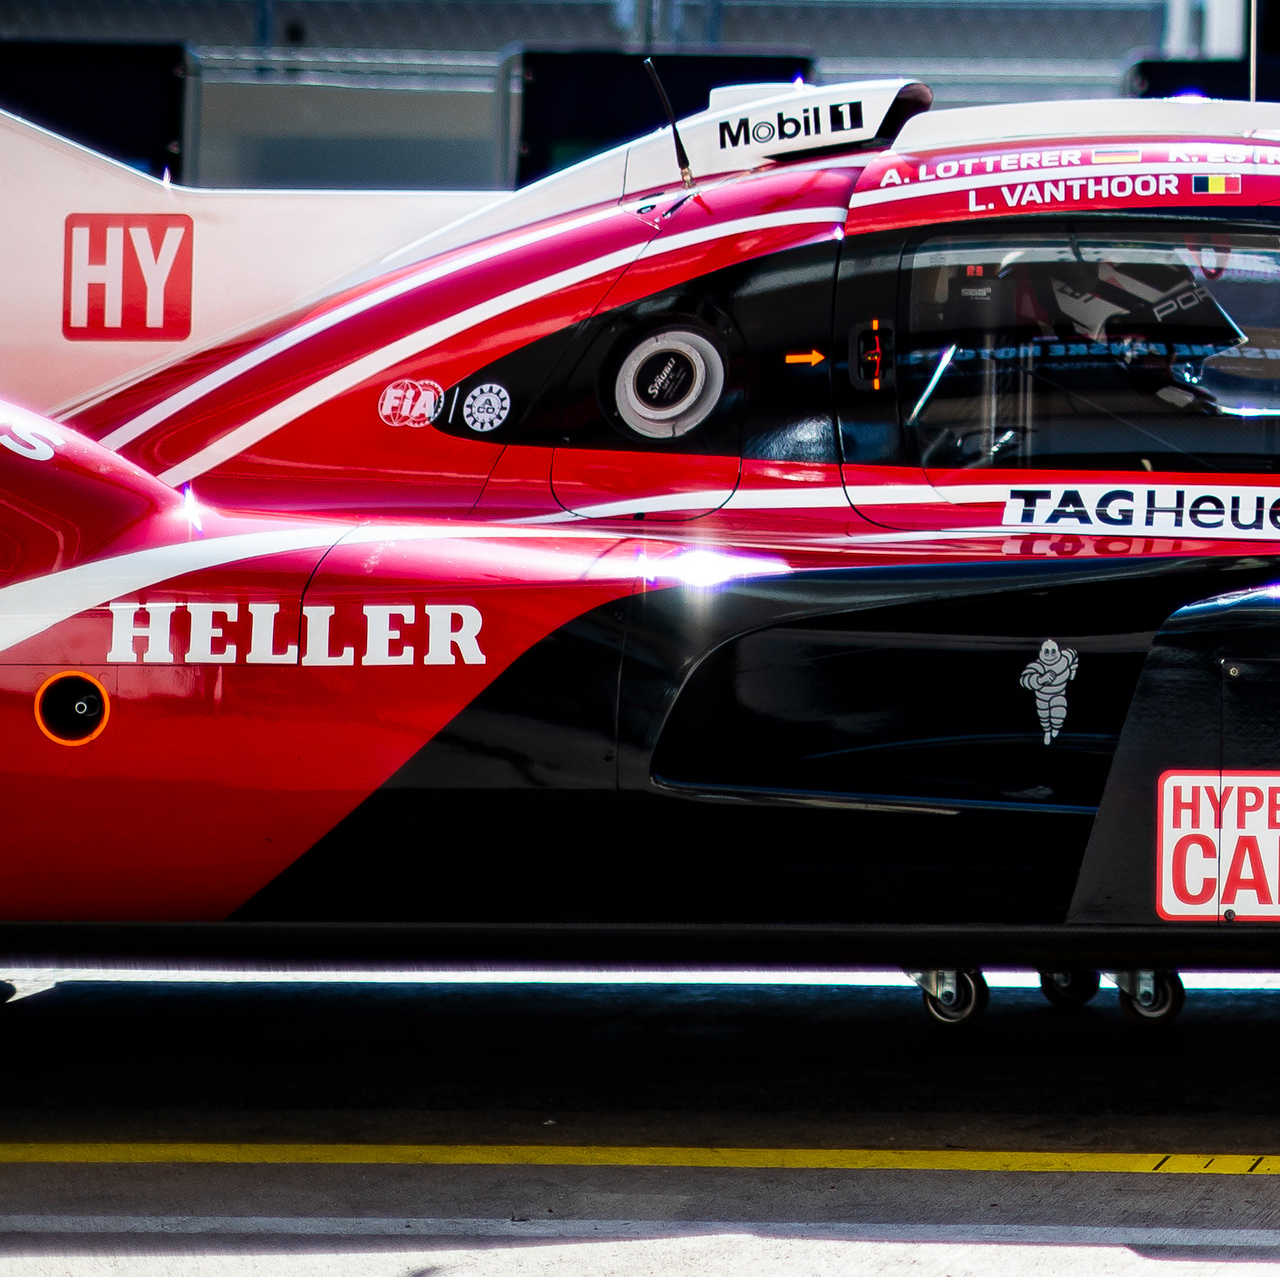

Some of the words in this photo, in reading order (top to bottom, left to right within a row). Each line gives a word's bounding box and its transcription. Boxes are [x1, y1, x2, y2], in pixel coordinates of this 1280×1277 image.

[719, 106, 822, 150] Mobil
[880, 167, 911, 188] A.
[919, 150, 1082, 179] LOTTERER
[968, 189, 995, 212] L.
[1001, 175, 1179, 207] VANTHOOR
[70, 226, 185, 329] HY
[107, 602, 487, 667] HELLER
